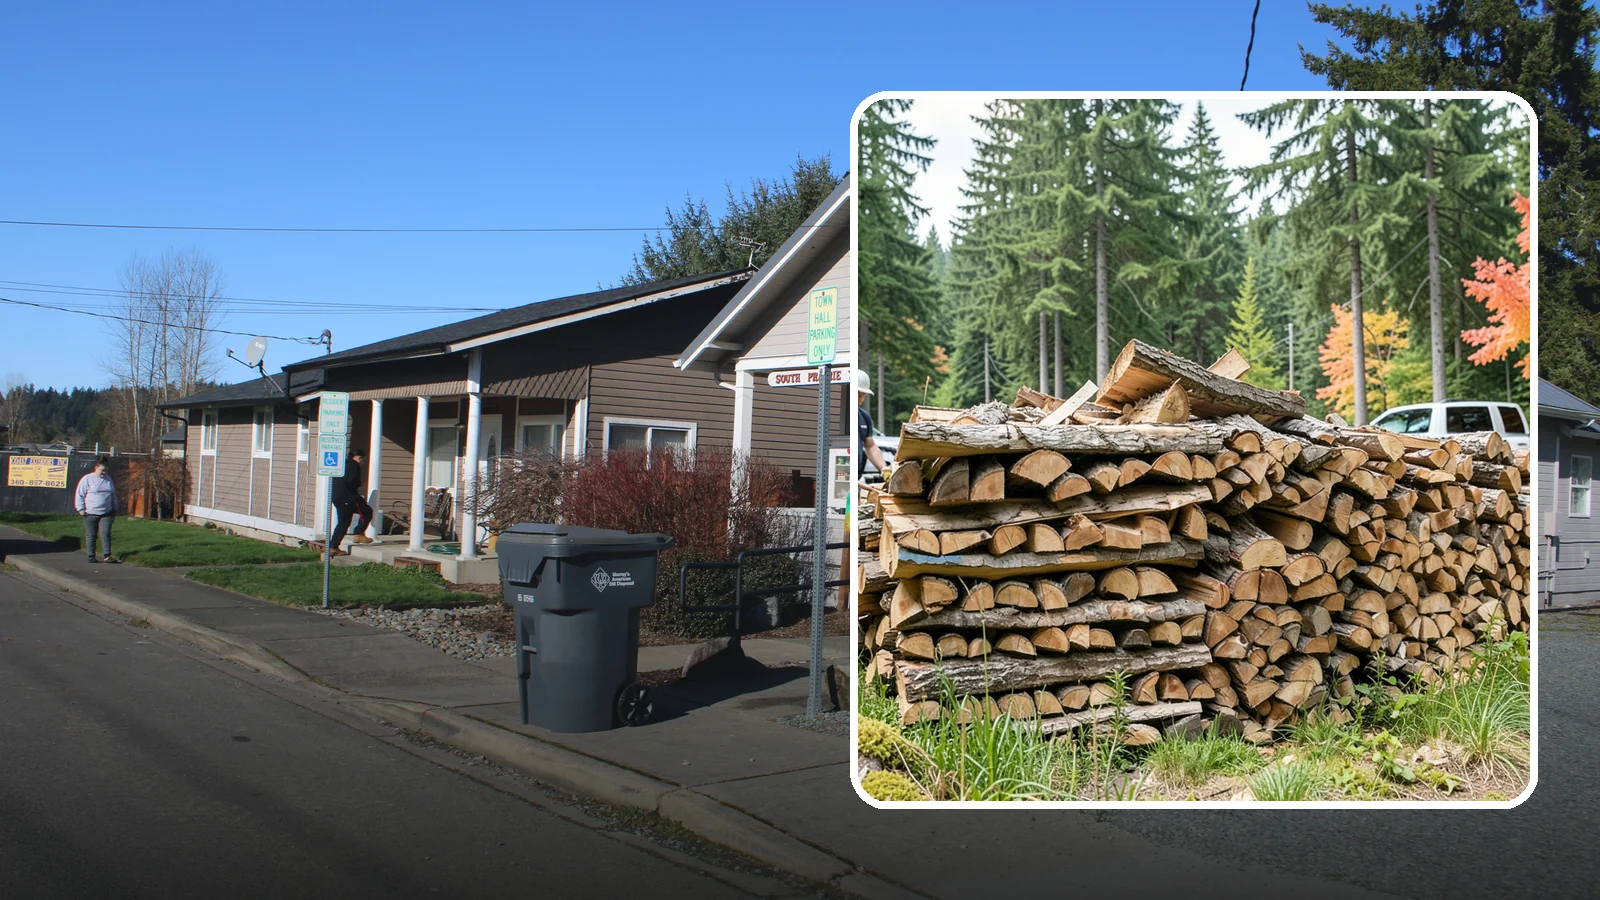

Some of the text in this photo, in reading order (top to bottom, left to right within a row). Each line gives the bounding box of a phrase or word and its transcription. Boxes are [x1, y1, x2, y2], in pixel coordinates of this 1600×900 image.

[815, 295, 833, 308] TOWN
[814, 312, 831, 324] HALL
[810, 327, 836, 341] PARKING
[813, 344, 831, 357] ONLY
[775, 373, 801, 384] SOUTH
[11, 457, 26, 465] COAST
